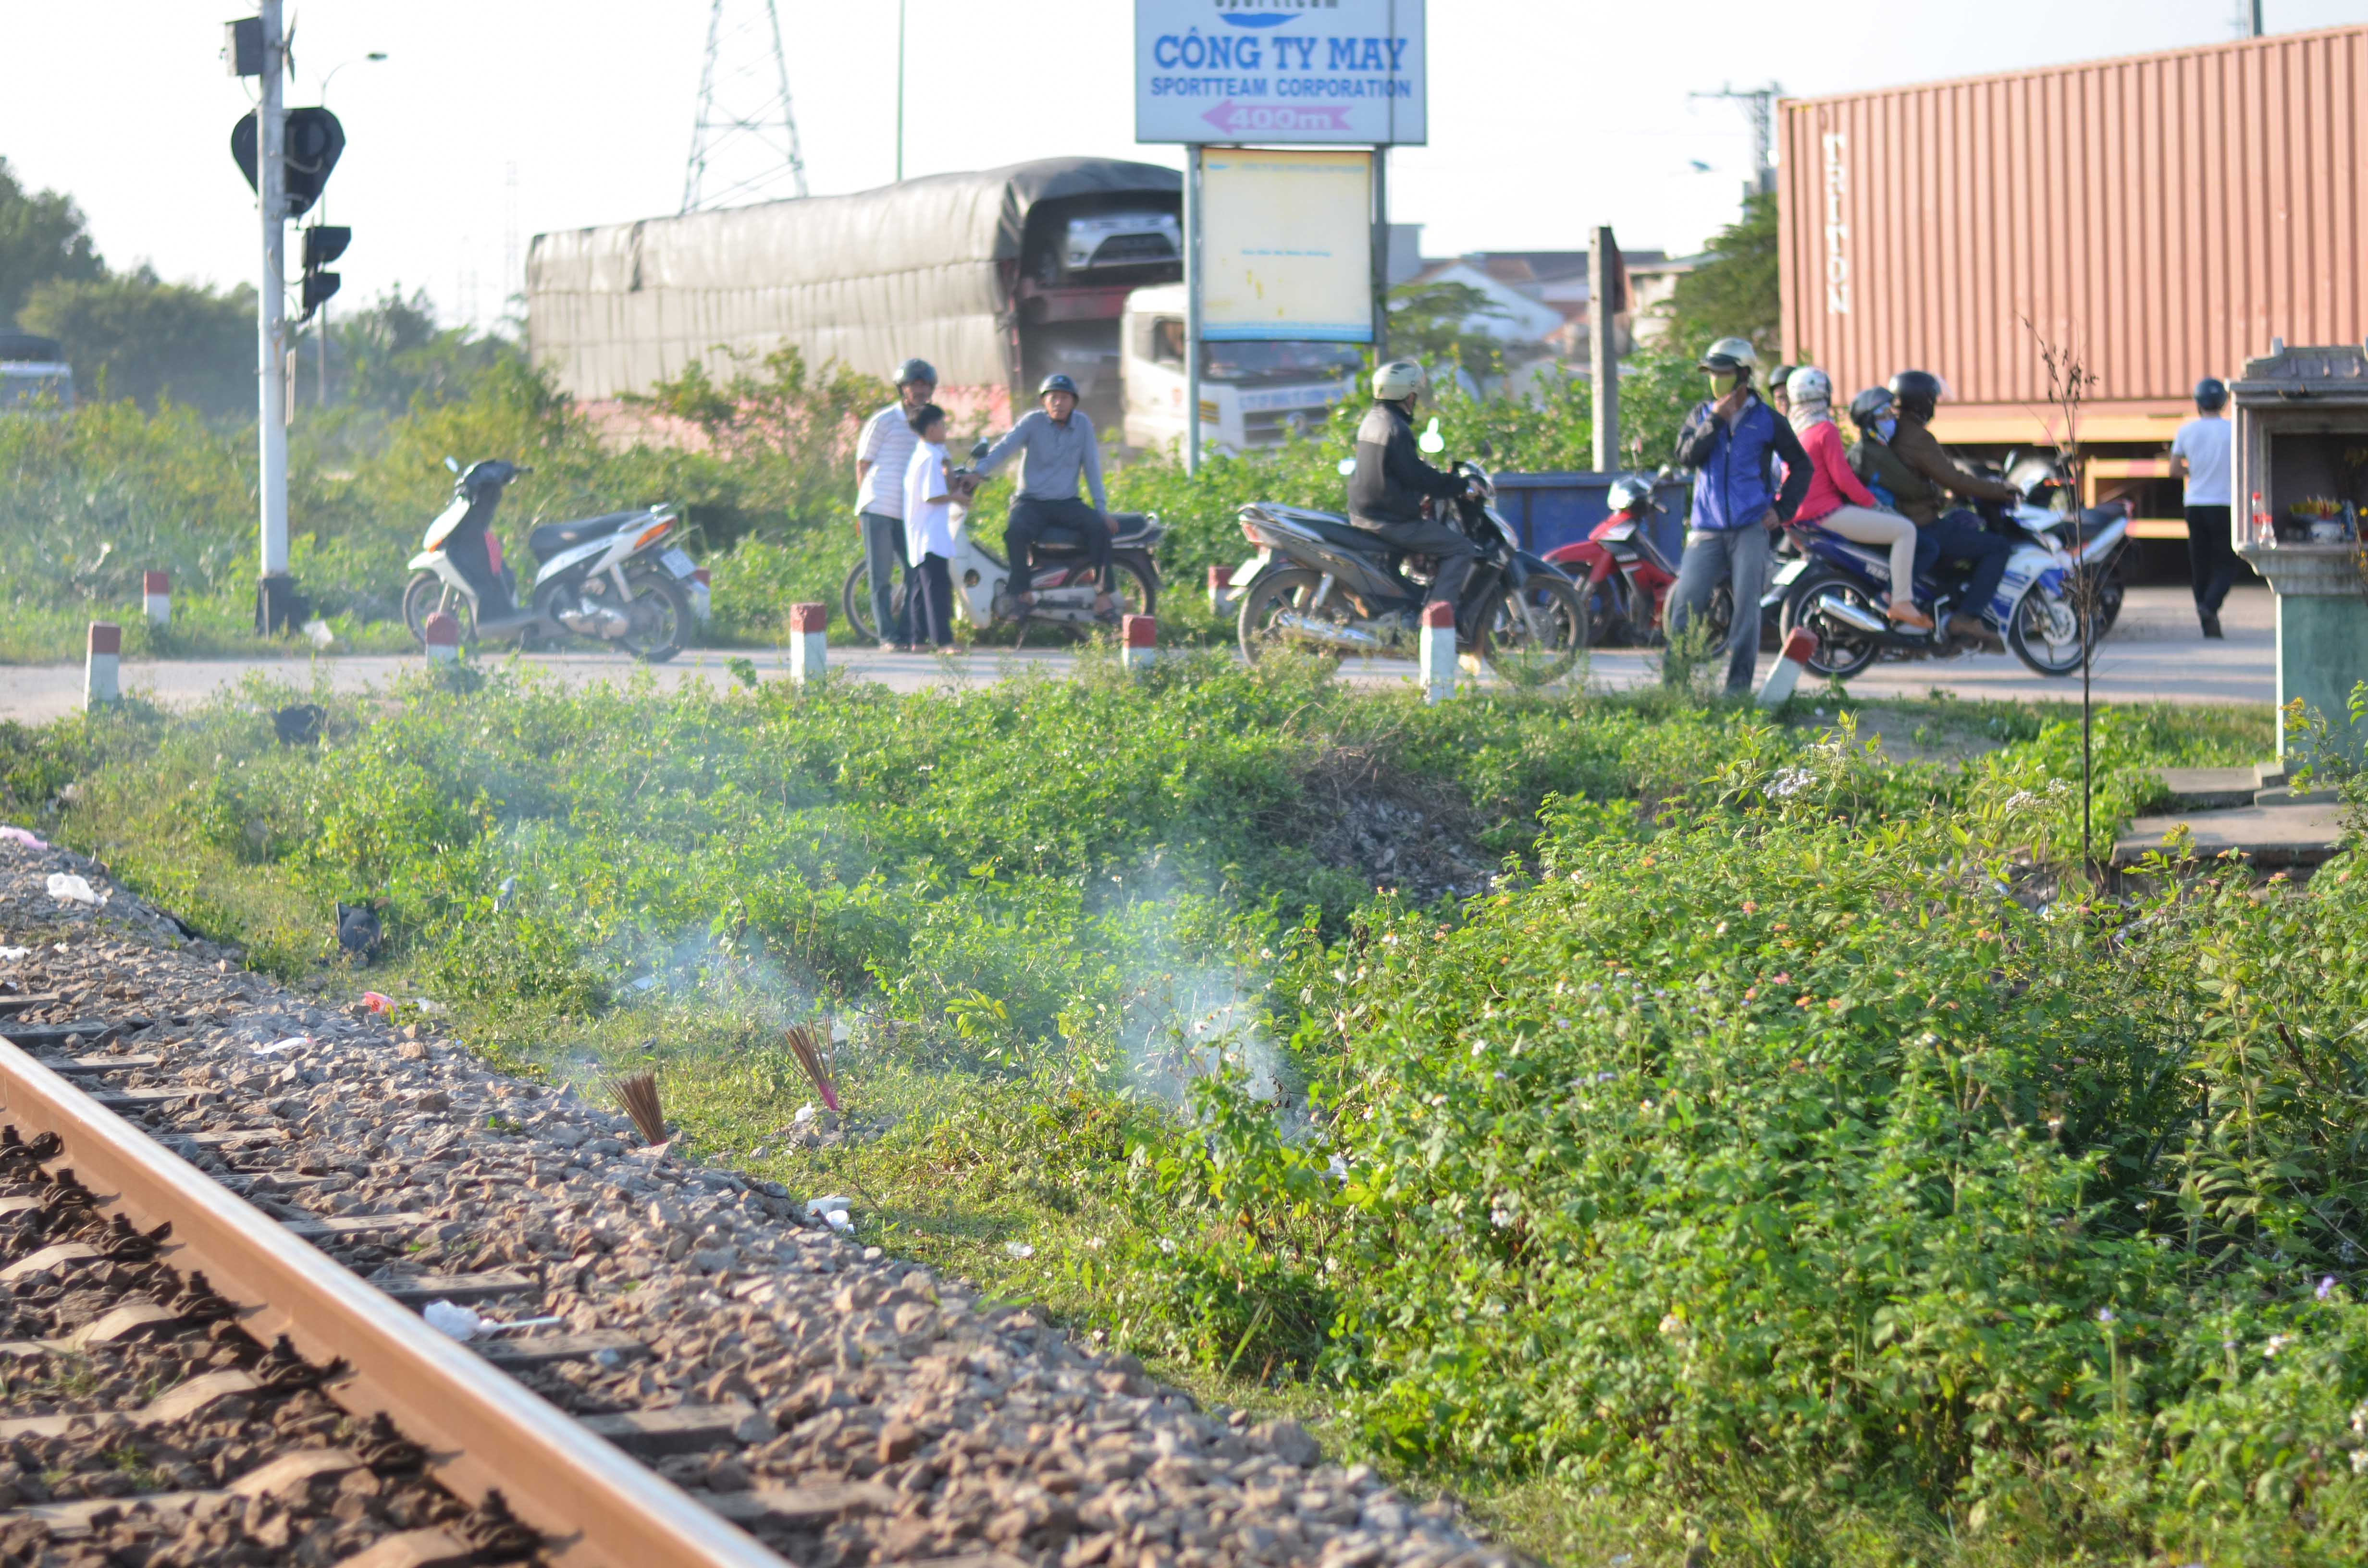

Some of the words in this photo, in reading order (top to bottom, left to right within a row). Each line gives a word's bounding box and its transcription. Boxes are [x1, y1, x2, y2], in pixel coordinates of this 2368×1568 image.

[1153, 25, 1263, 70] CÔNG
[1272, 36, 1318, 70] TY
[1328, 37, 1408, 72] MAY
[1151, 77, 1268, 97] SPORTTEAM
[1276, 78, 1411, 98] CORPORATION
[1228, 108, 1332, 129] 400m
[1823, 132, 1851, 315] TRITON
